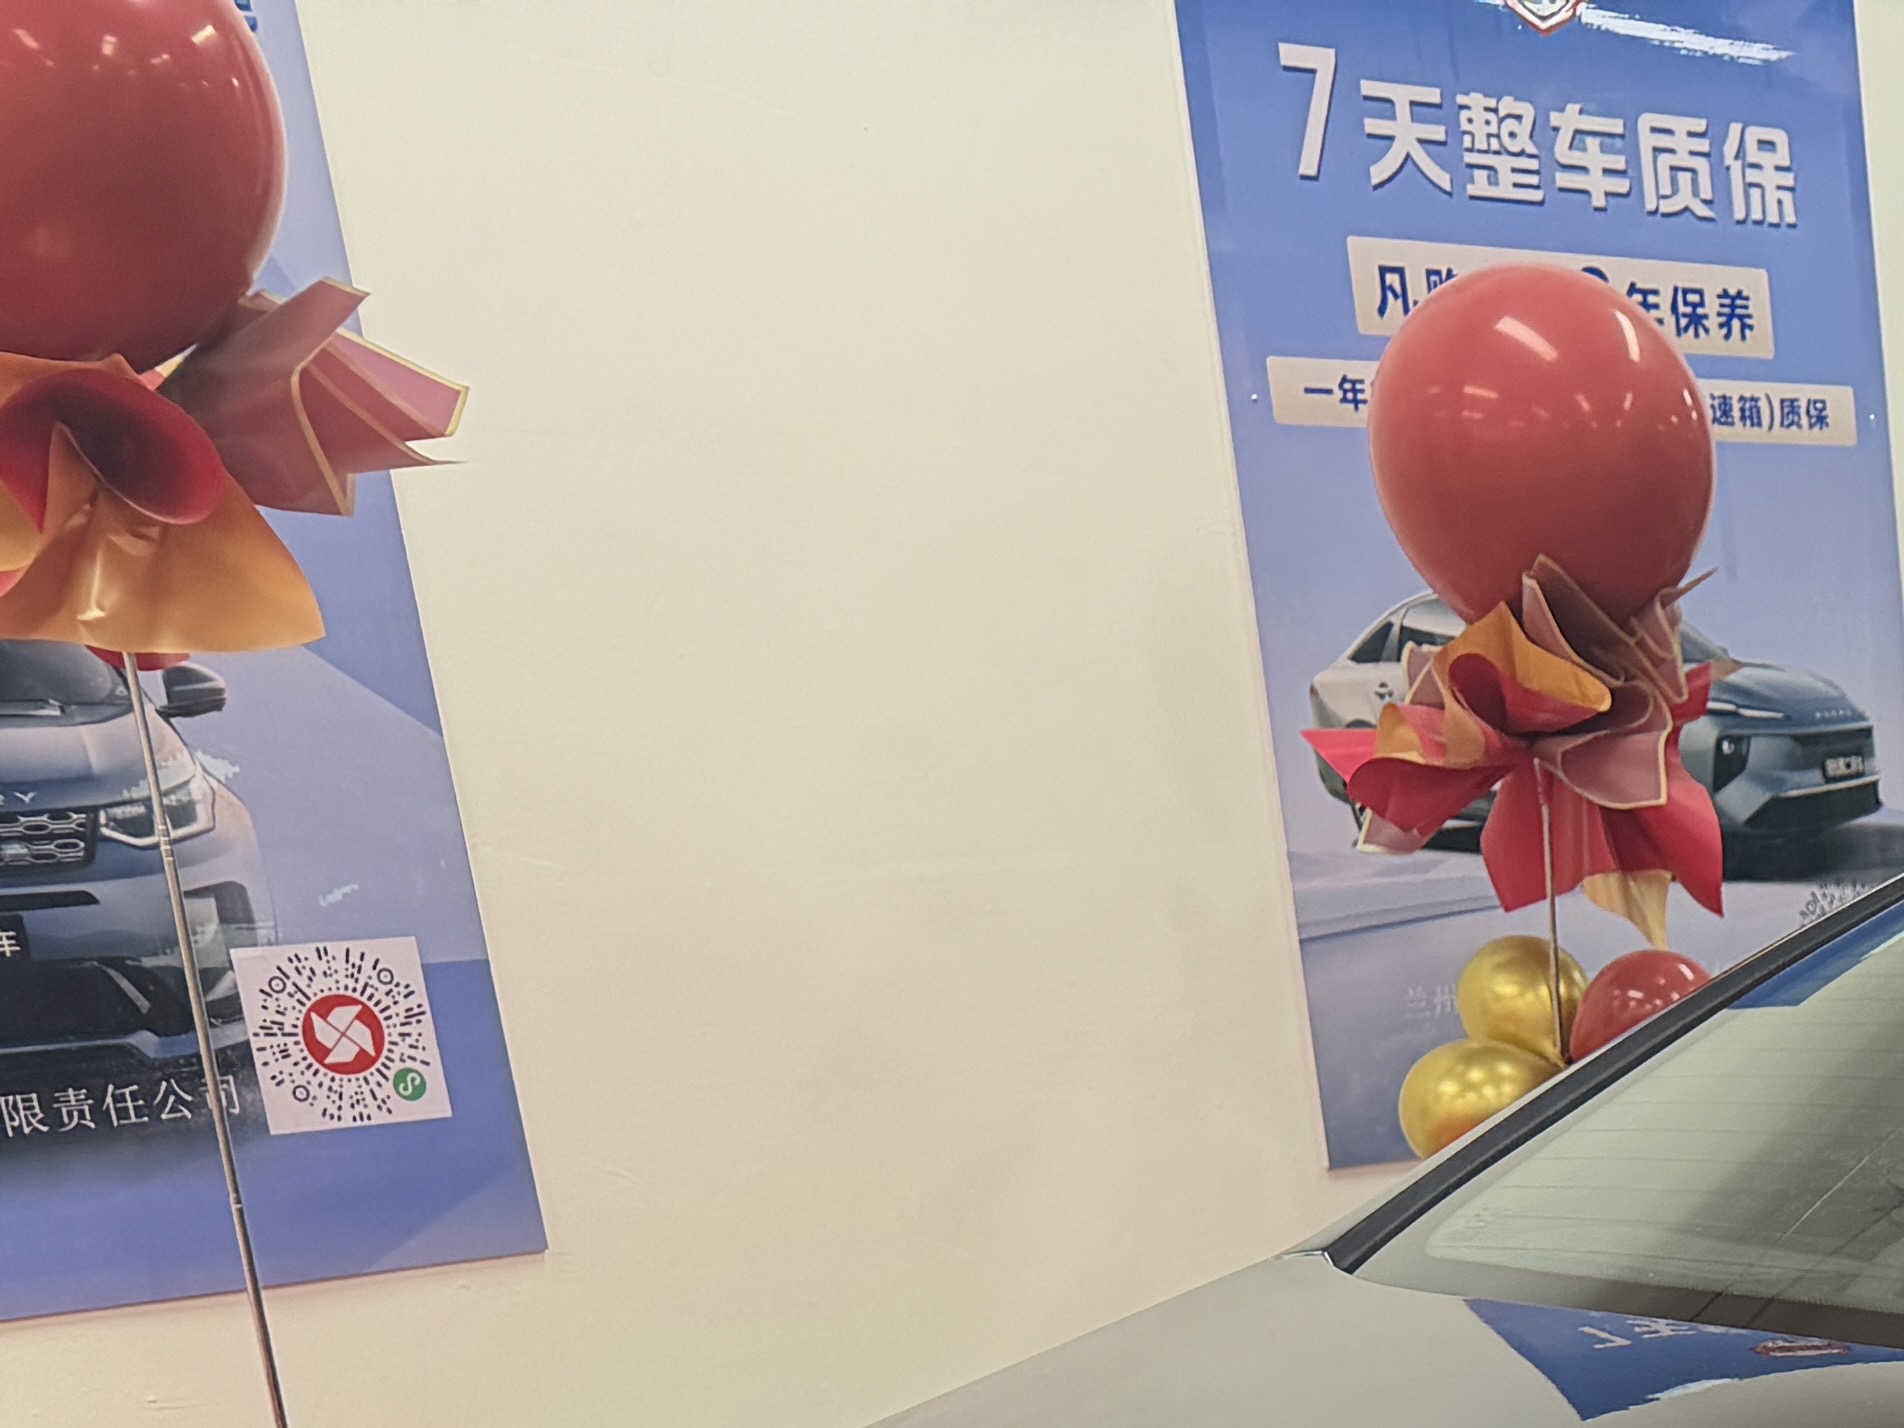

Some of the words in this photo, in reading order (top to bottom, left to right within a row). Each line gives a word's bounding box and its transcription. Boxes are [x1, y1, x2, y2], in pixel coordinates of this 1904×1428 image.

[1276, 41, 1799, 228] 7天整车质保
[1709, 392, 1831, 432] 速箱)质保
